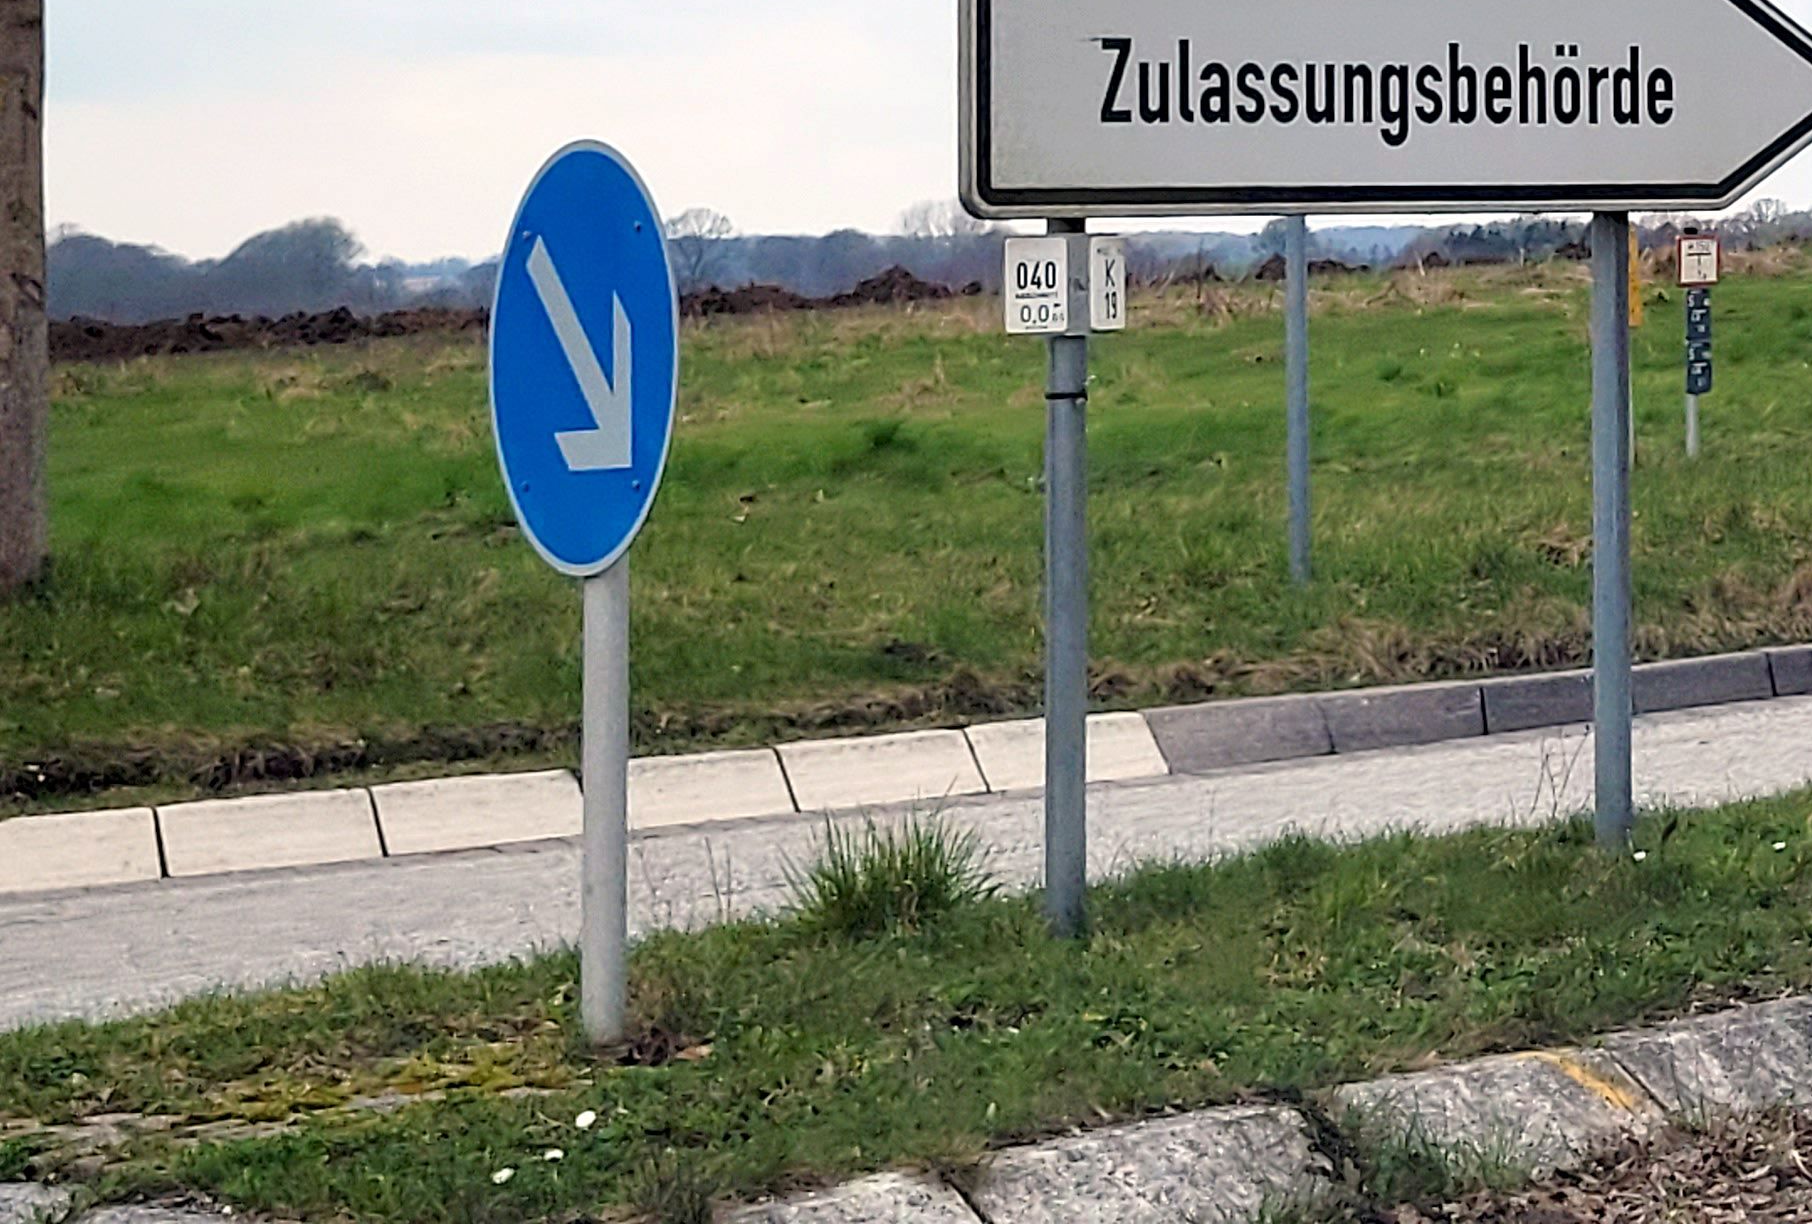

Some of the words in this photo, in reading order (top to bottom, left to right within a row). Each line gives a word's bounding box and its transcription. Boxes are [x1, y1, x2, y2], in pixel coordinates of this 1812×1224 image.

[1100, 37, 1674, 147] Zulassungsbehörde
[1016, 261, 1057, 290] 040
[1104, 259, 1116, 287] K
[1020, 304, 1050, 324] 0.0
[1104, 291, 1118, 319] 19
